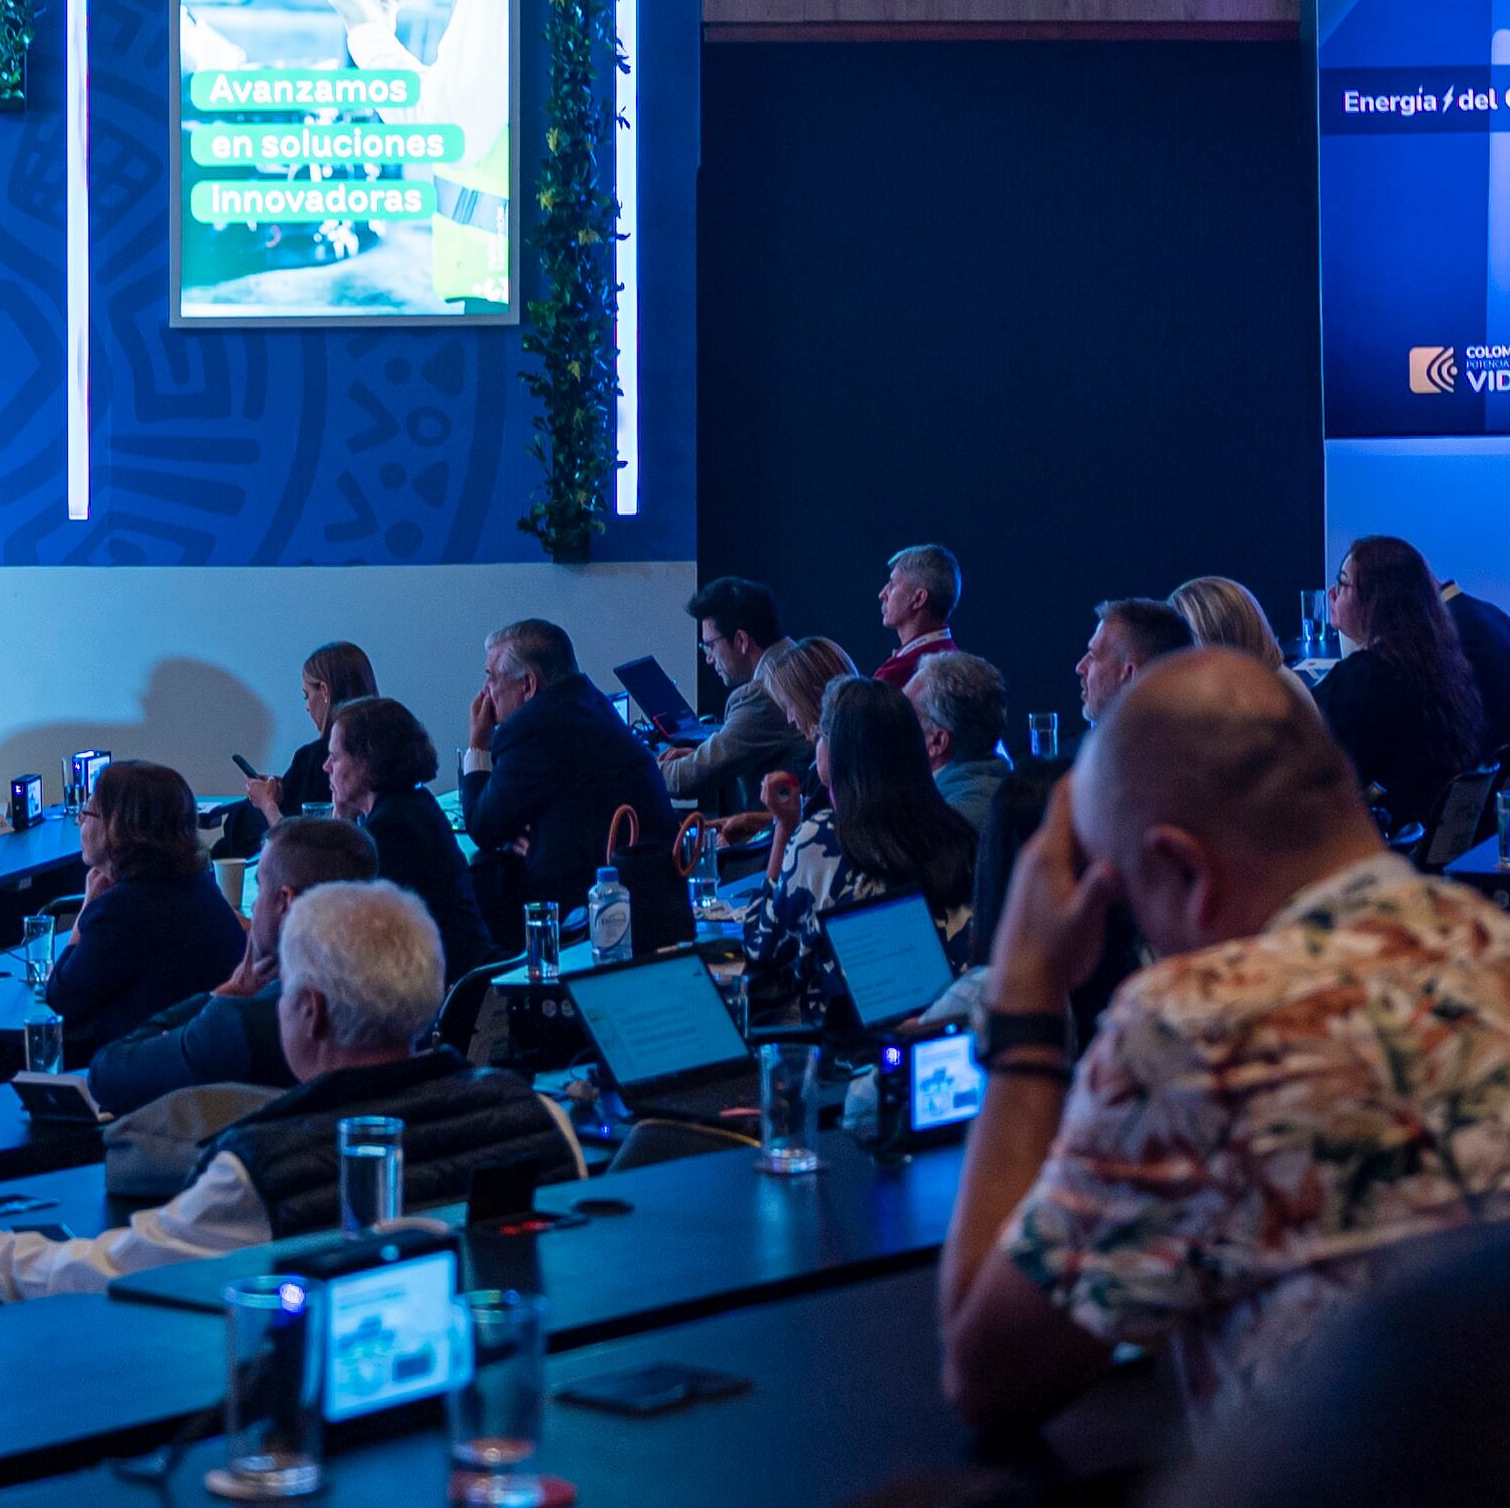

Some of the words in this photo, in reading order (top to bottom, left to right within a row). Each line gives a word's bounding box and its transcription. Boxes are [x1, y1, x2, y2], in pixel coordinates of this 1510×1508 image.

[209, 73, 408, 104] Avanzamos
[1344, 85, 1438, 117] Energía
[1458, 88, 1498, 111] del
[211, 135, 252, 159] en
[261, 127, 445, 158] soluciones
[211, 183, 423, 214] innovadoras
